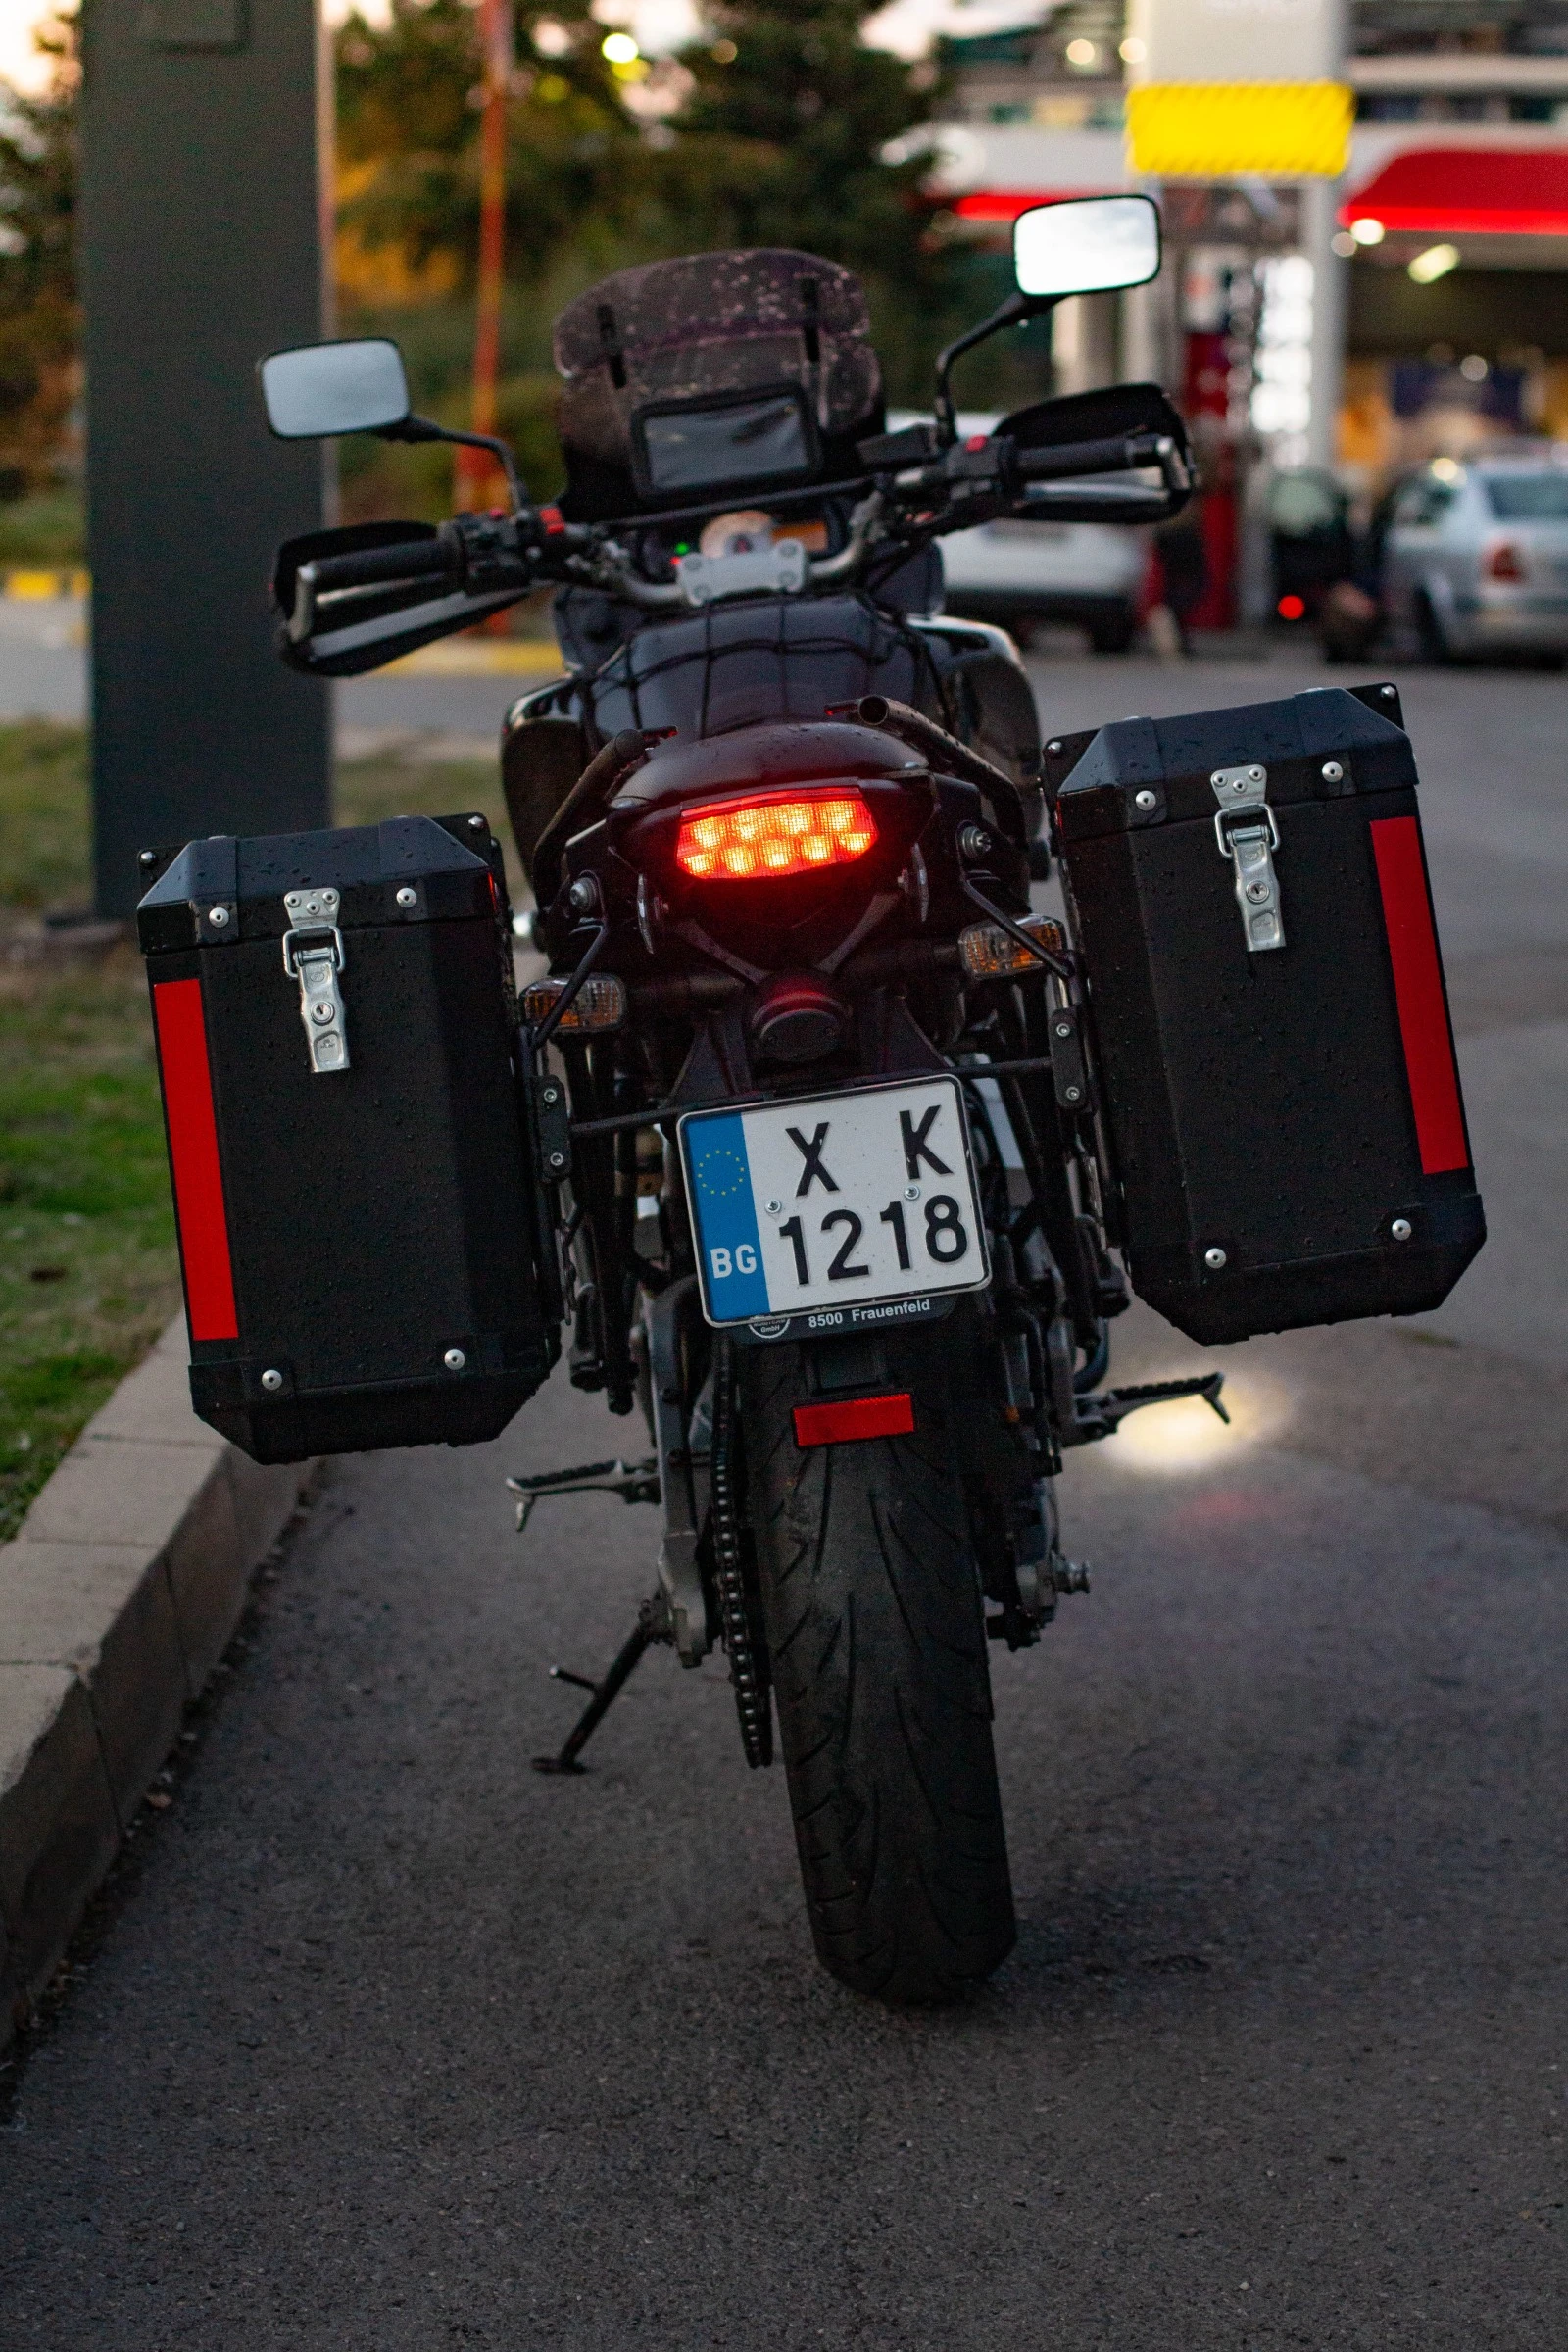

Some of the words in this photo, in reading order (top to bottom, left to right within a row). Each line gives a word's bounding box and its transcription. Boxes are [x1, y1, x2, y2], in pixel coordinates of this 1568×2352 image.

[785, 1122, 840, 1198] X
[899, 1105, 954, 1179] K
[779, 1195, 968, 1285] 1218
[710, 1245, 758, 1279] BG
[760, 1324, 780, 1333] GmbH
[808, 1312, 844, 1328] 8500
[851, 1299, 931, 1322] Frauenfeld
